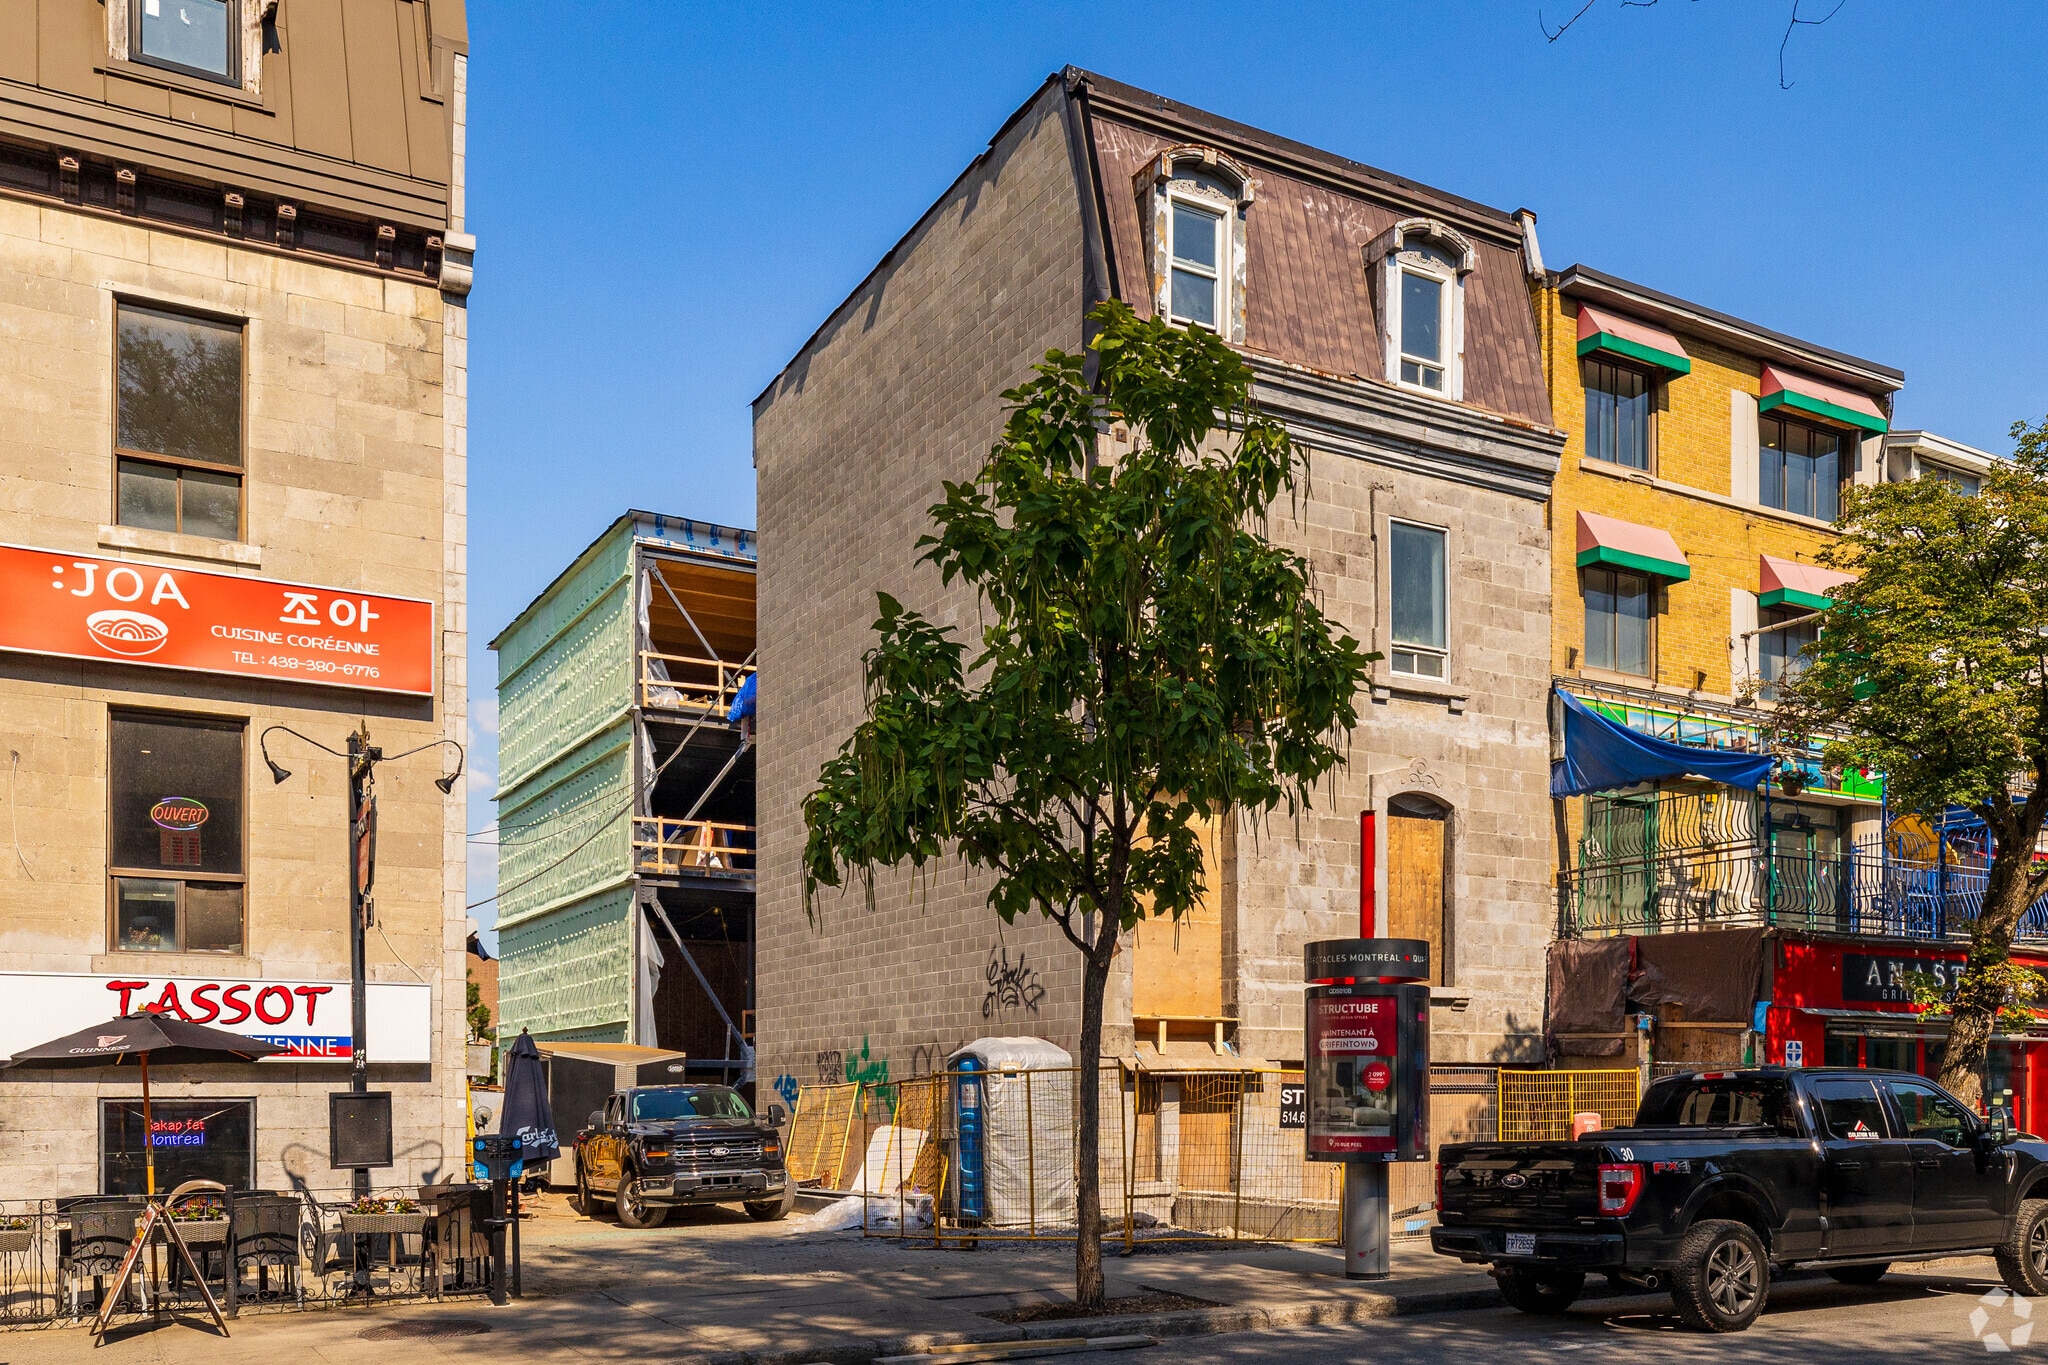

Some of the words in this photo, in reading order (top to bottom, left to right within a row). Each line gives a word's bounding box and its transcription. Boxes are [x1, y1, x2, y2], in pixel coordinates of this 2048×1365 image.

[279, 591, 380, 633] 조아
[211, 625, 283, 645] CUISINE
[287, 635, 380, 656] CORÉENNE
[267, 655, 380, 679] 438-380-6776
[154, 806, 204, 822] OUVERT
[1349, 951, 1400, 962] MONTRÉAL
[106, 980, 333, 1026] TASSOT
[1318, 1003, 1379, 1015] STRUCTUBE
[1321, 1028, 1367, 1037] MAINTENANT
[1368, 1026, 1375, 1036] À
[69, 1044, 131, 1055] GUINNESS
[1320, 1040, 1375, 1048] GRIFFINTOWN
[1282, 1111, 1306, 1123] 514.6
[1620, 1147, 1634, 1162] 30
[1653, 1160, 1691, 1174] FX4
[1506, 1238, 1535, 1250] FRT2655
